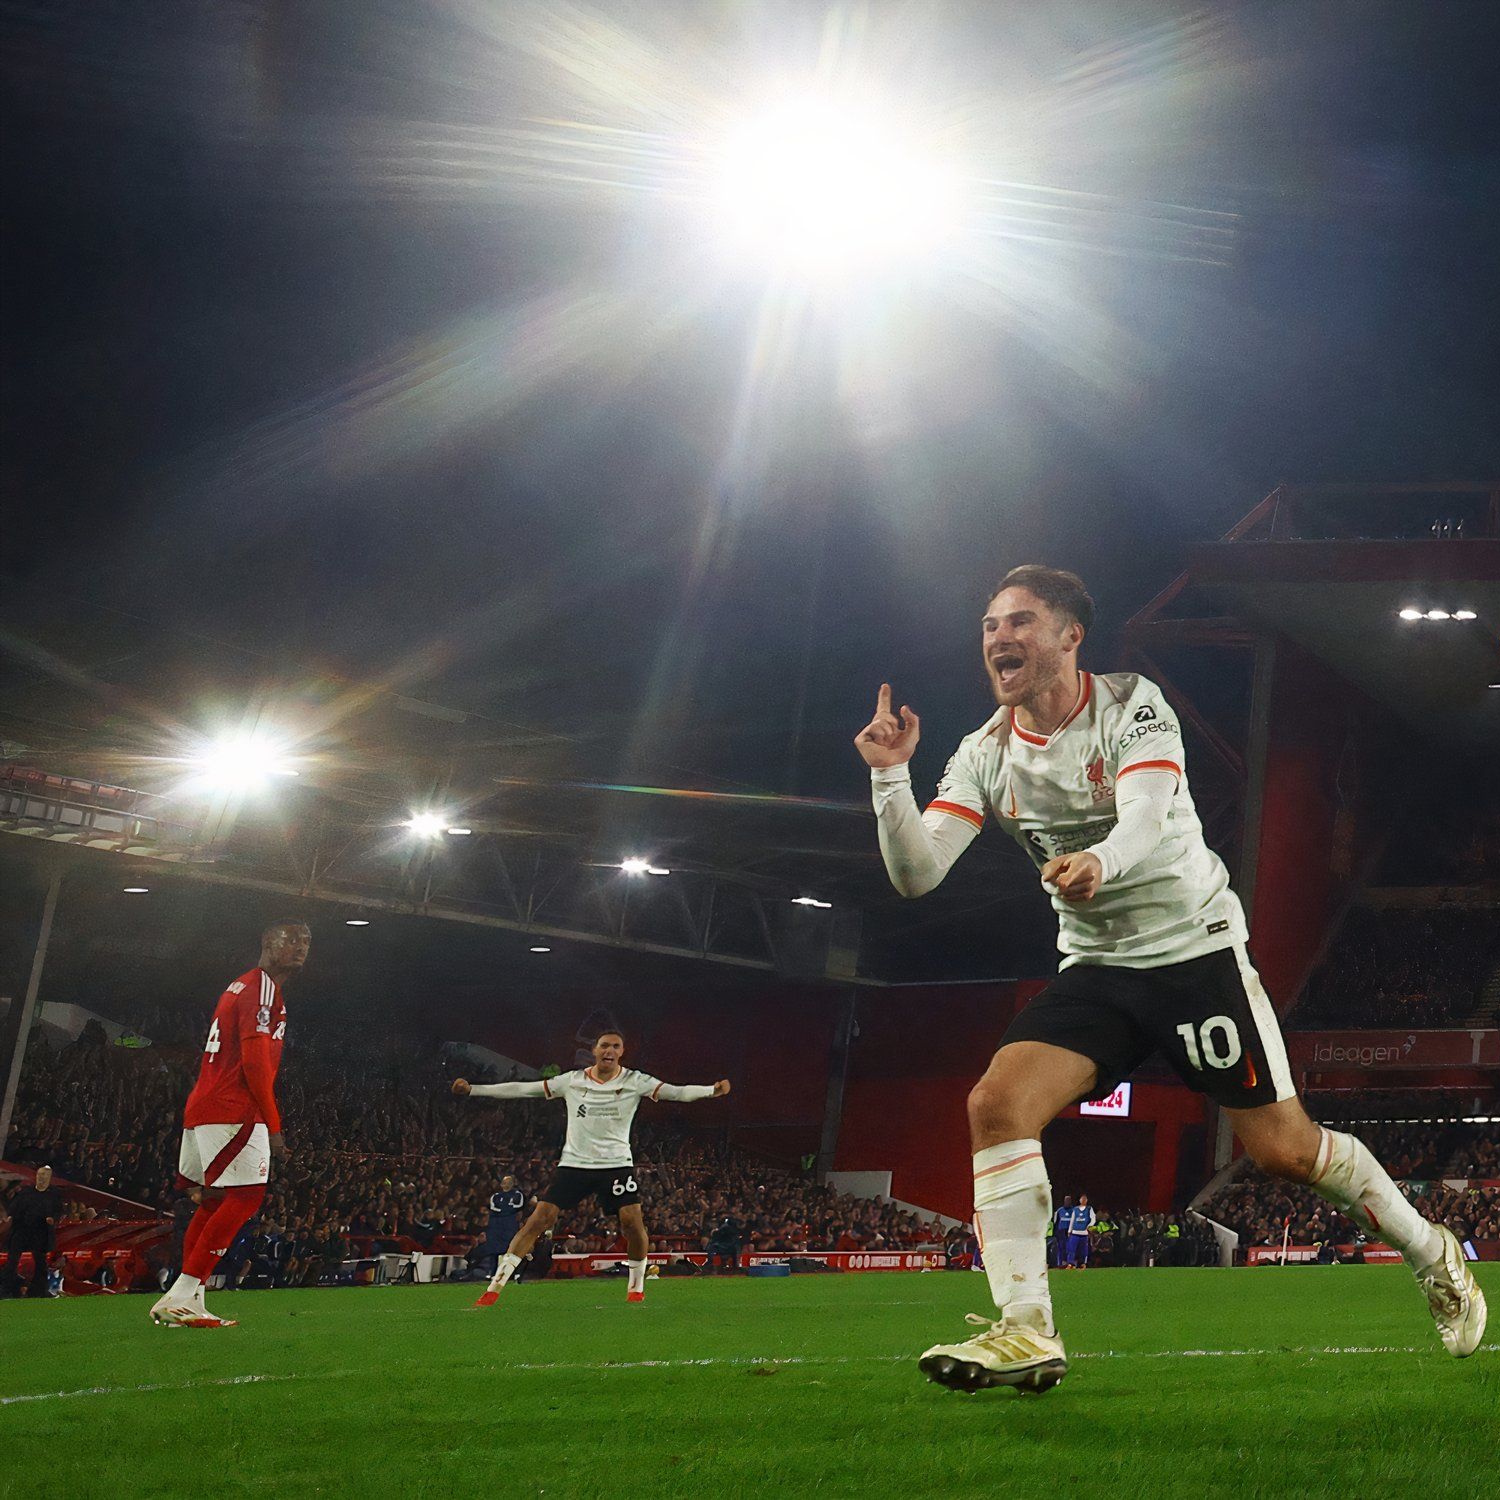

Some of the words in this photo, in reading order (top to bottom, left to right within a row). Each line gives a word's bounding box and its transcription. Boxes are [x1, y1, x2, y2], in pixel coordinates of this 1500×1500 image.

[1176, 1015, 1242, 1071] 10
[1314, 1042, 1399, 1065] Ideagen
[612, 1175, 638, 1196] 66
